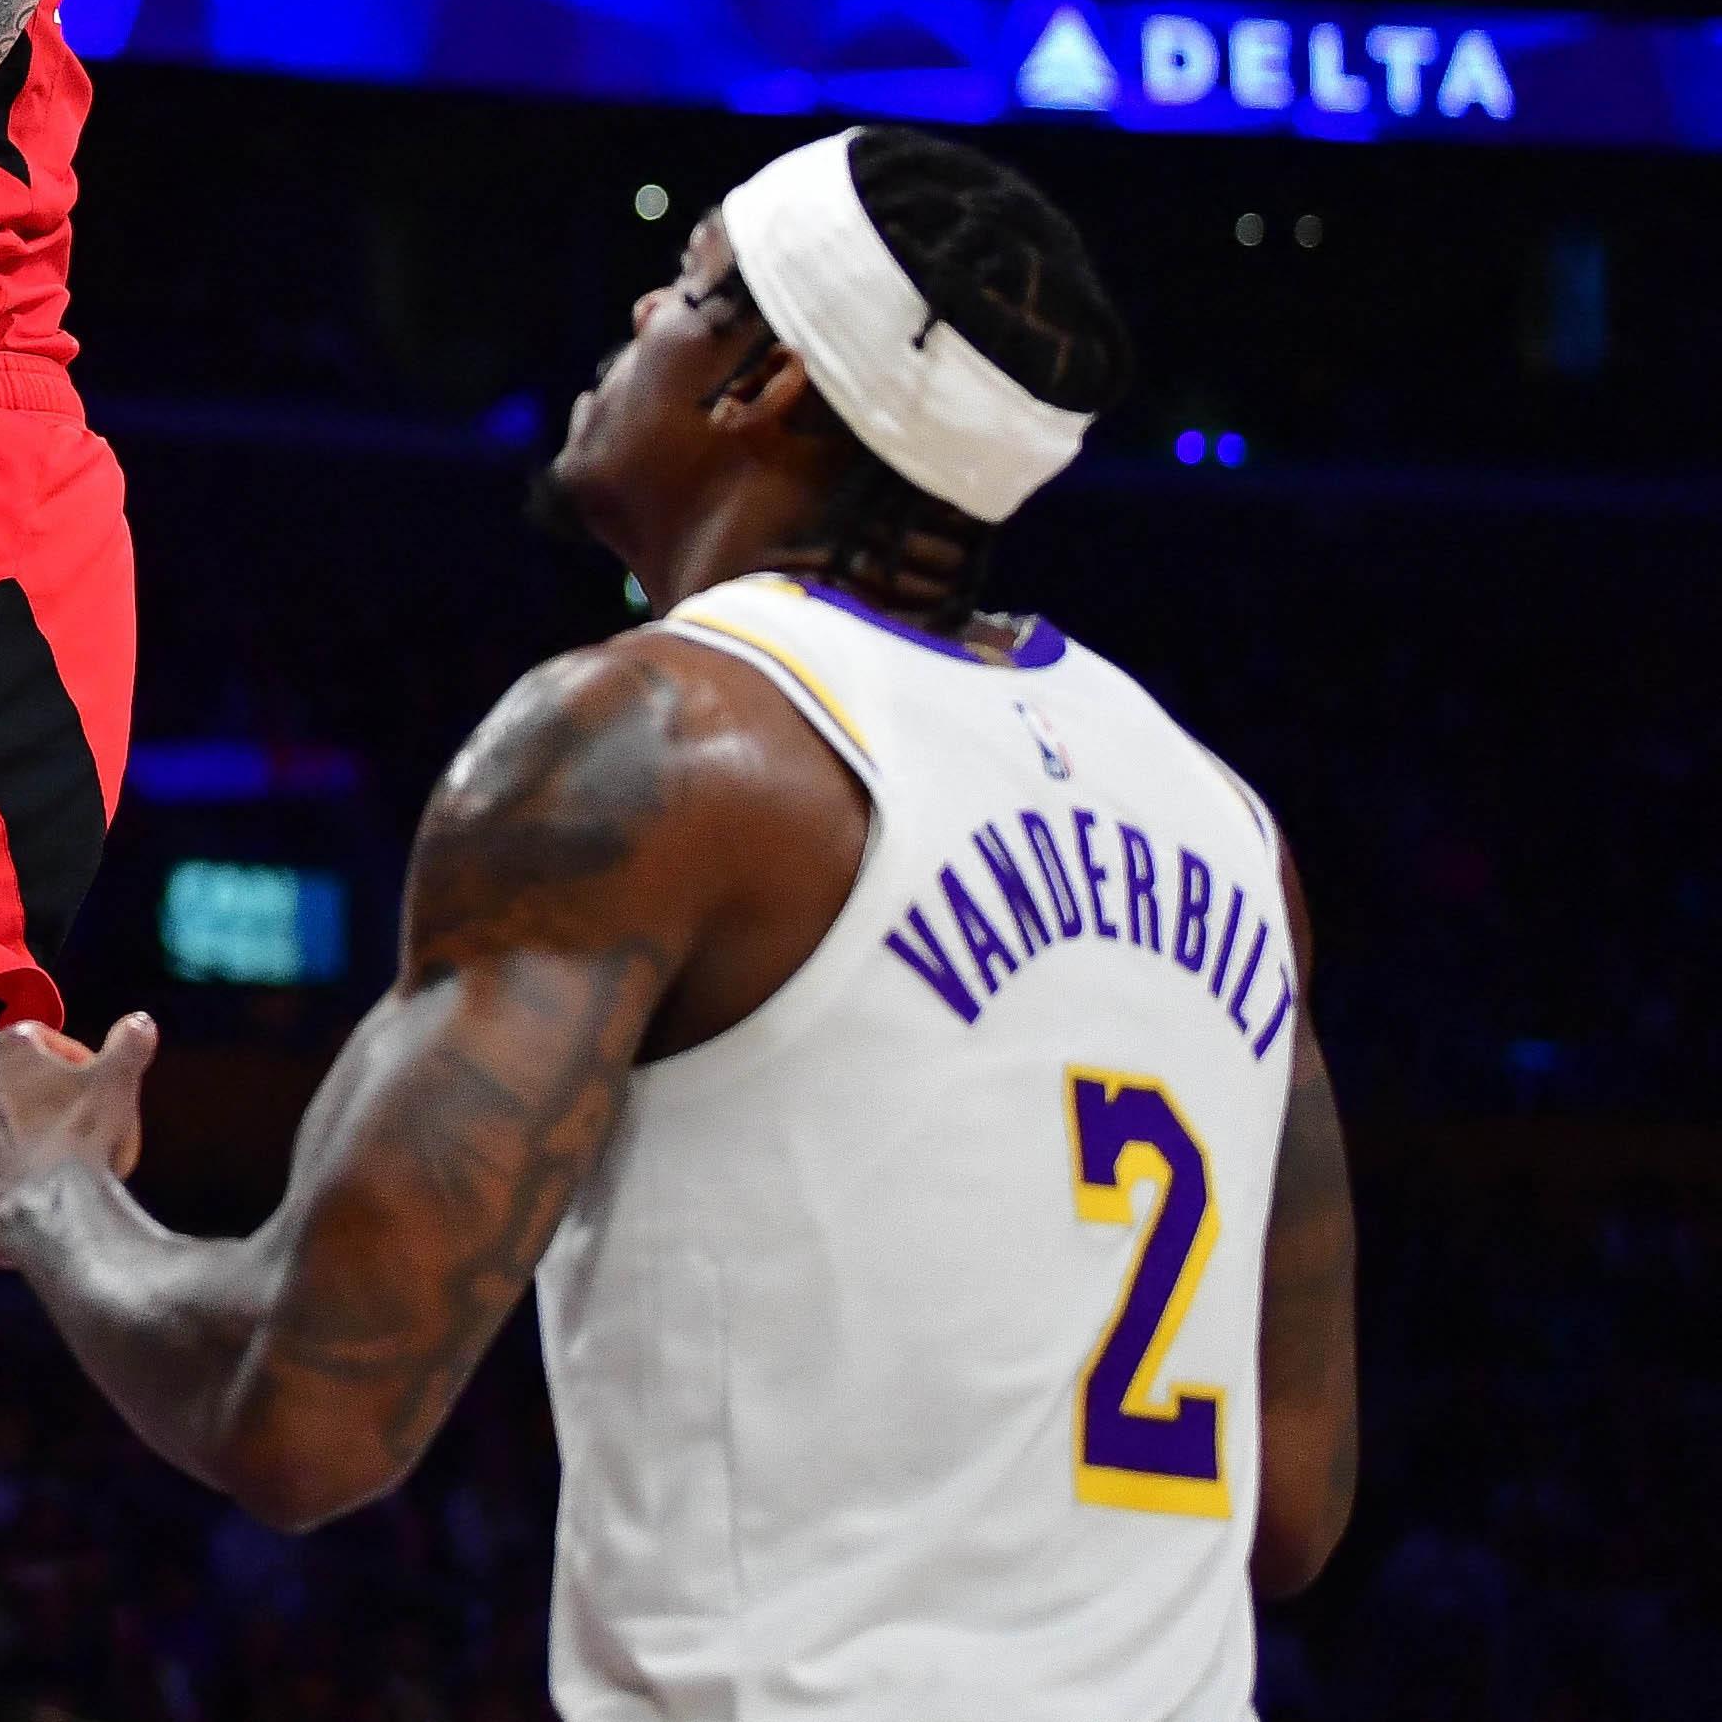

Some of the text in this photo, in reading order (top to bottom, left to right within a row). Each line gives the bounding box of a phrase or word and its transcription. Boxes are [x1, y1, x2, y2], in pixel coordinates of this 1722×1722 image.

[1139, 14, 1516, 121] DELTA
[884, 805, 1298, 1061] VANDERBILT
[1063, 1063, 1234, 1520] 2
